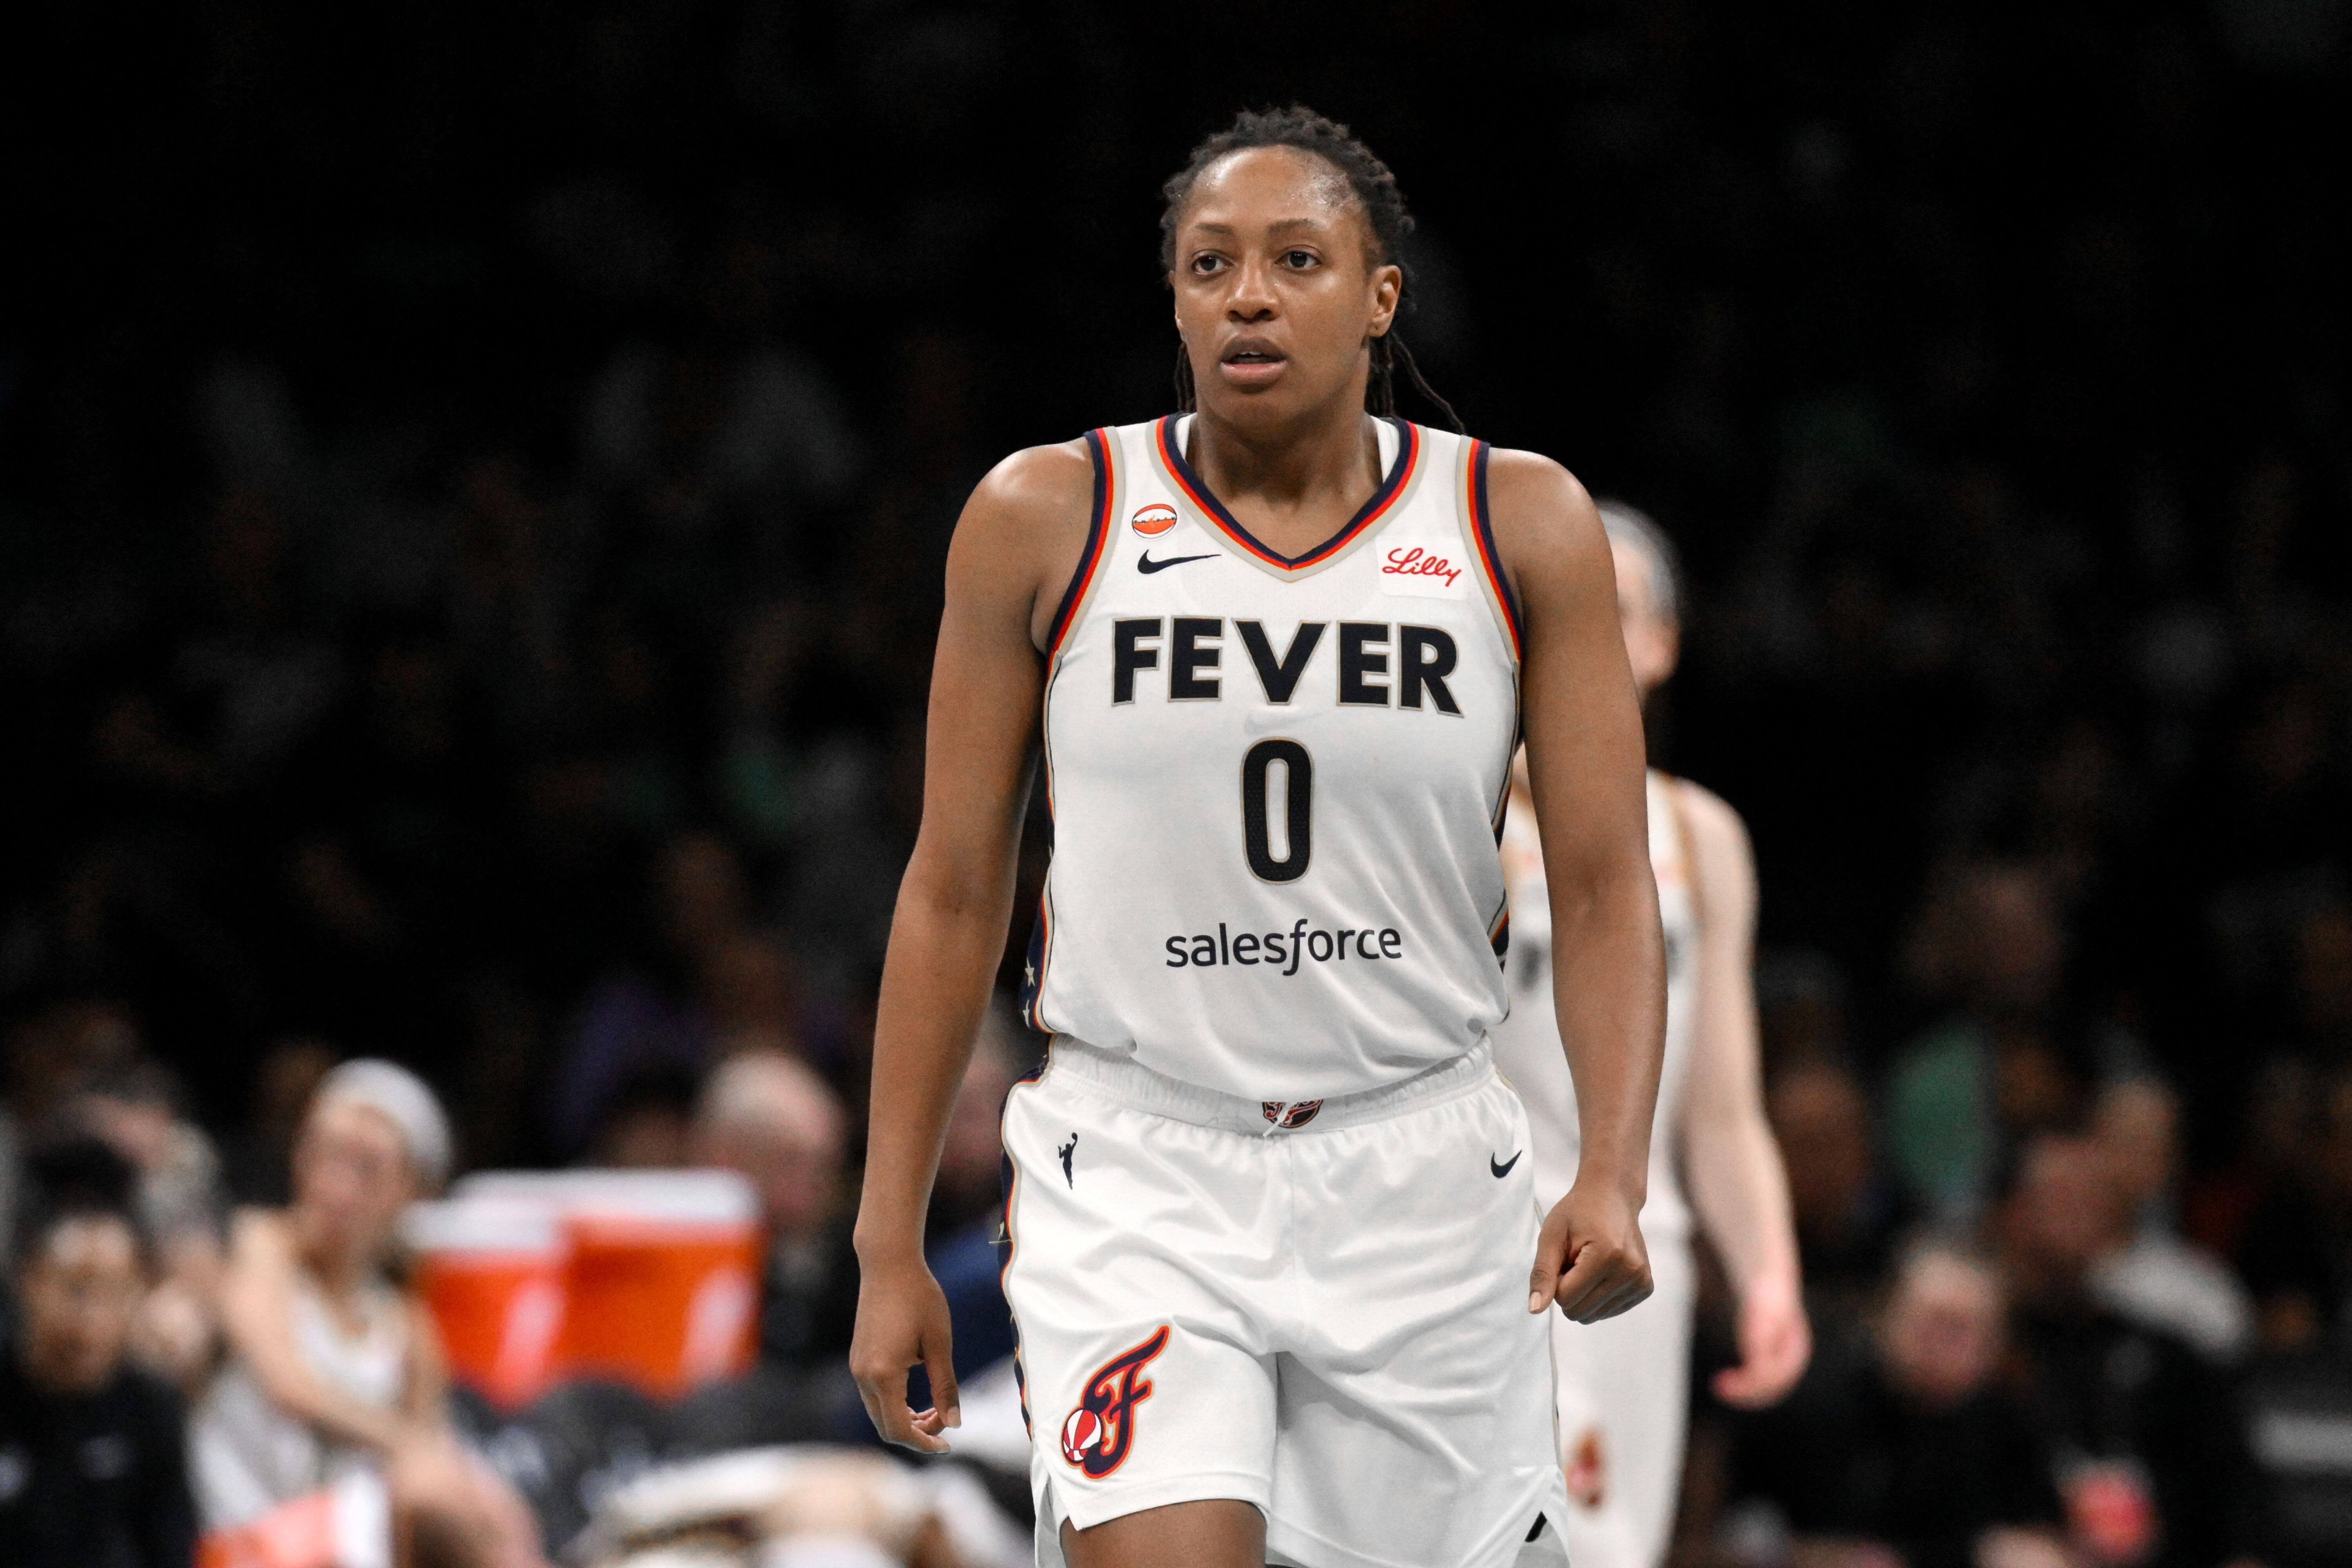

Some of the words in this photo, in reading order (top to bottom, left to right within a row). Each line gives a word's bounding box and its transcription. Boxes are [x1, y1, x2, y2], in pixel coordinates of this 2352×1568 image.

[1382, 547, 1462, 587] Lilly
[1112, 616, 1465, 718] FEVER
[1240, 737, 1315, 885] 0
[1165, 918, 1402, 976] salesforce
